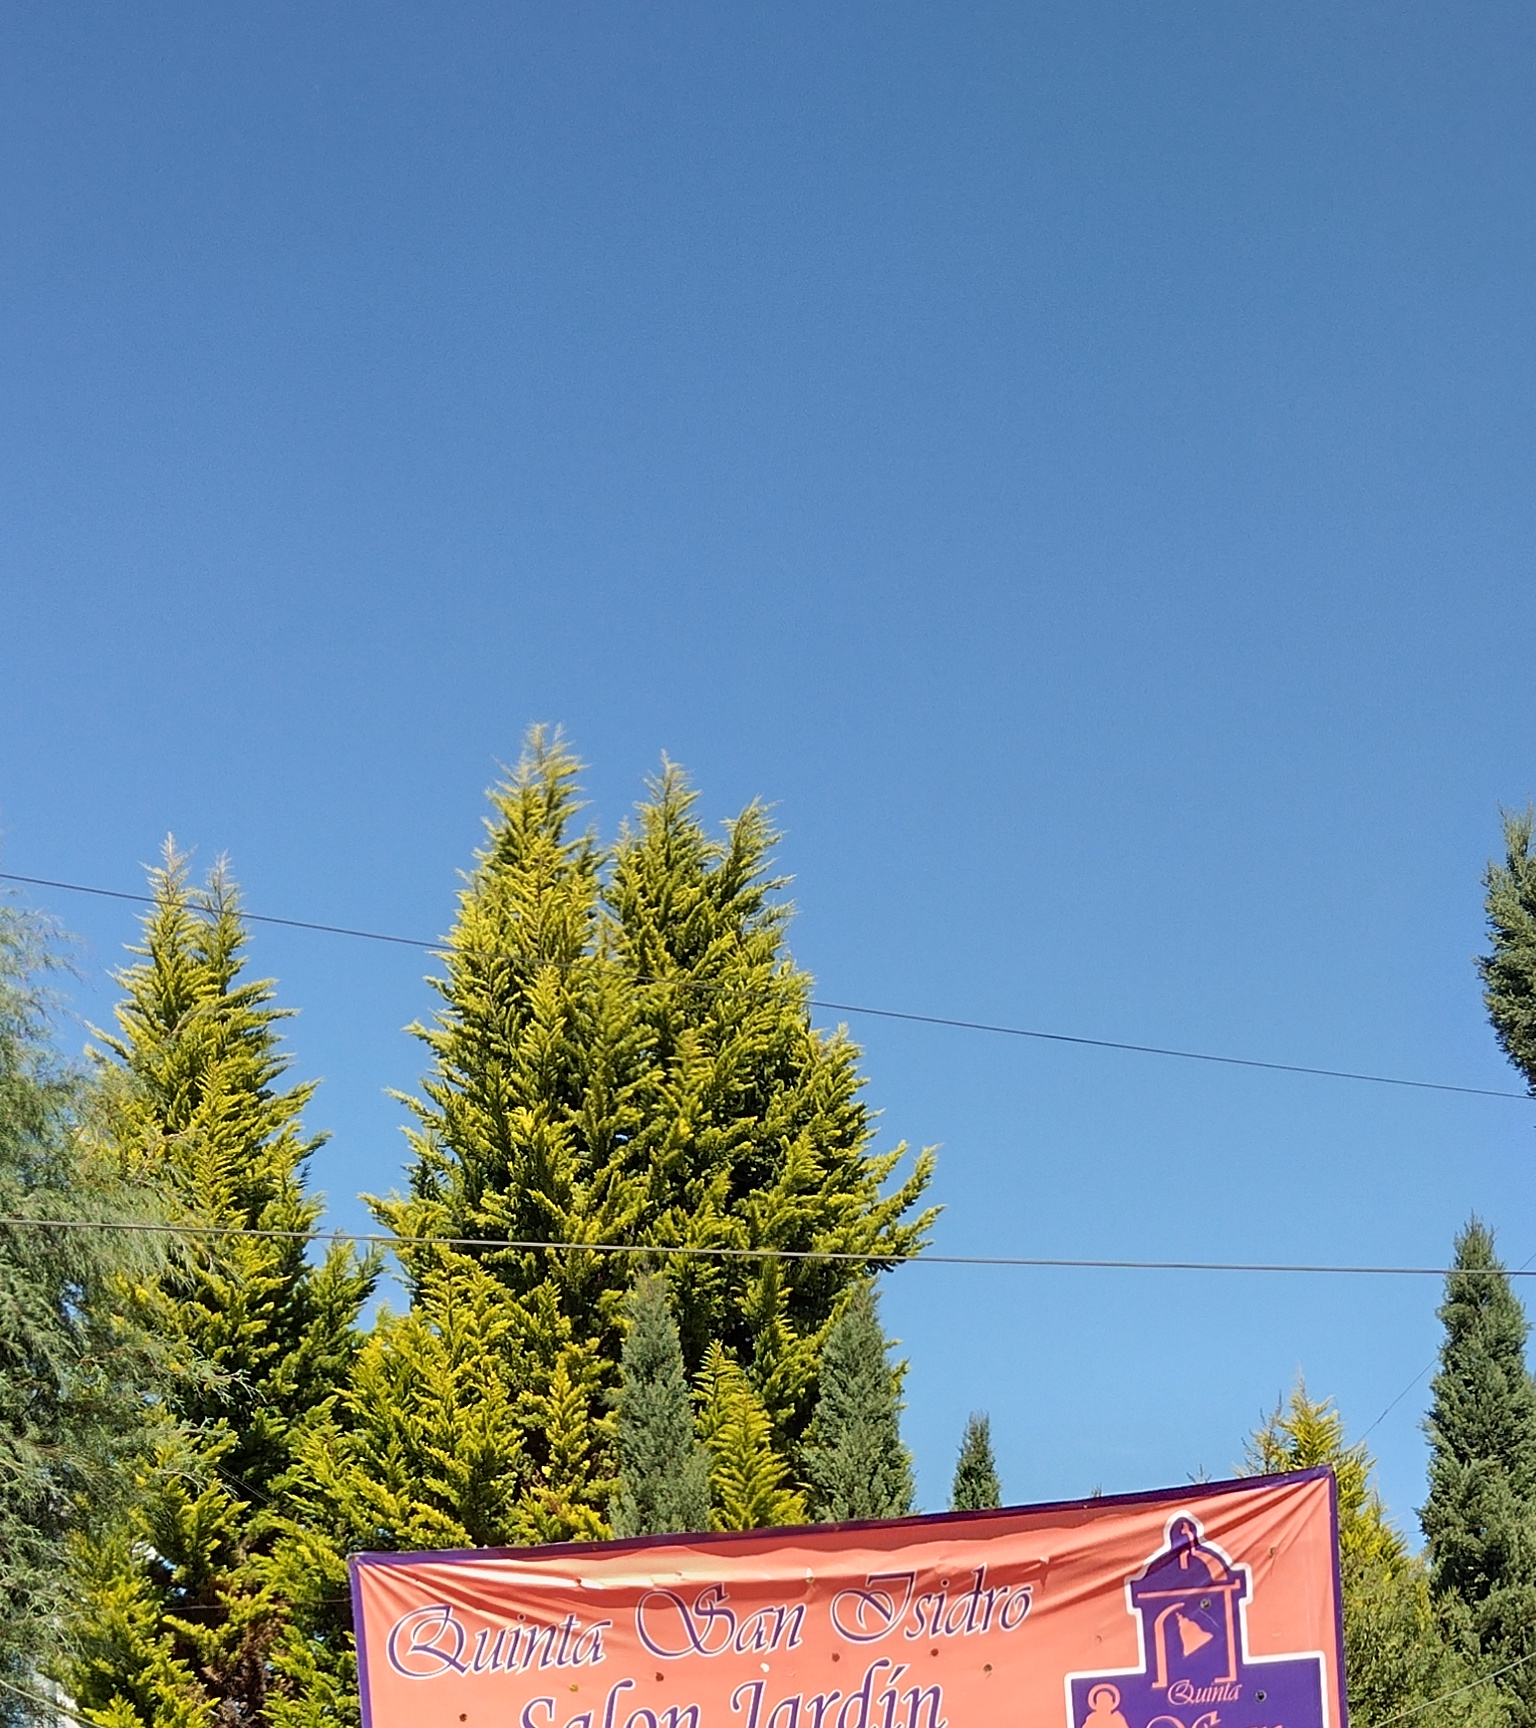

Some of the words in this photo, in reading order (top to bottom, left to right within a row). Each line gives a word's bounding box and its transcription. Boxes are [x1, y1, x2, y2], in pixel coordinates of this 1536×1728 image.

[387, 1605, 612, 1678] Quinta
[636, 1584, 805, 1660] San
[831, 1564, 1032, 1643] Isidro
[1167, 1679, 1243, 1706] Quinta
